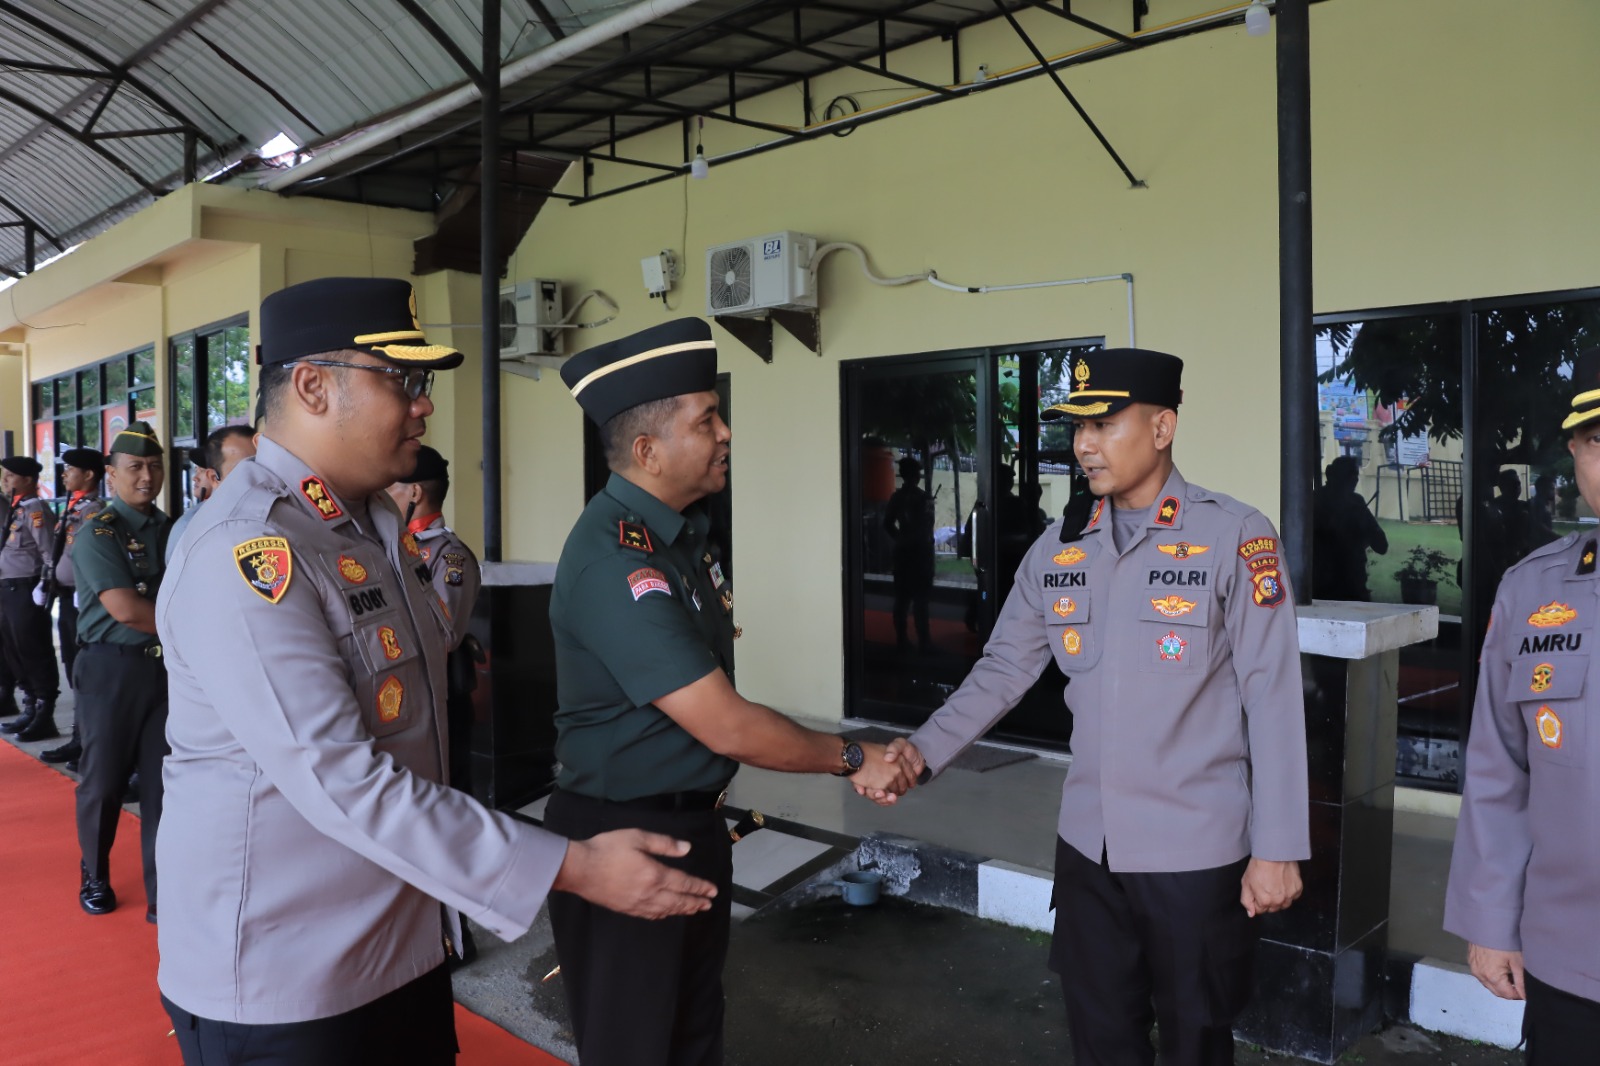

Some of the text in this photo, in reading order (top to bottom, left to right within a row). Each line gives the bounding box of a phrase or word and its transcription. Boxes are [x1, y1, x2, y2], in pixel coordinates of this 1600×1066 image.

[238, 539, 285, 555] RESERSE
[1251, 558, 1275, 569] RIAU
[1044, 571, 1086, 588] RIZKI
[1149, 570, 1207, 586] POLRI
[349, 587, 388, 616] BOBY
[1518, 633, 1582, 656] AMRU
